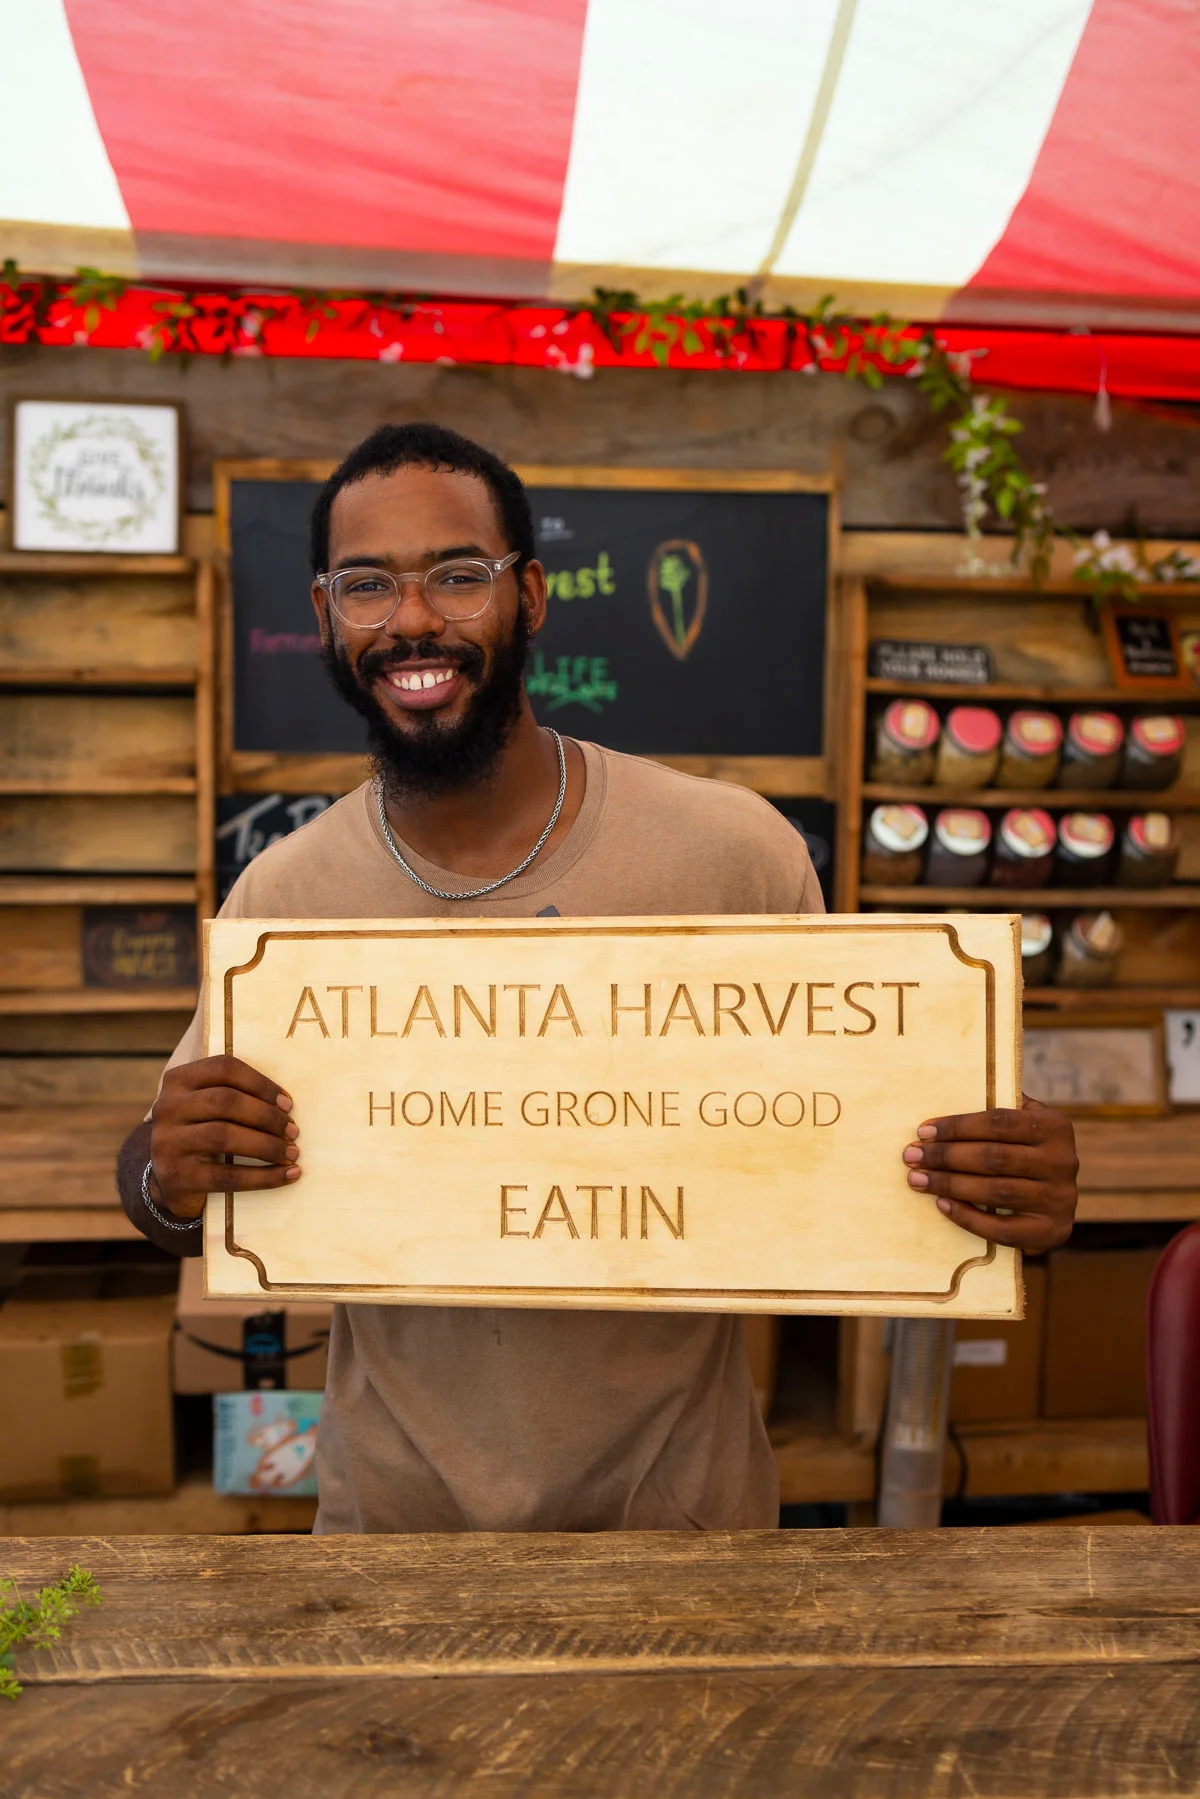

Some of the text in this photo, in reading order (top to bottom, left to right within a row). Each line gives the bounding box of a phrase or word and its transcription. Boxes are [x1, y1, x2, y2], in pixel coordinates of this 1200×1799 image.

[286, 981, 920, 1039] ATLANTA HARVEST
[368, 1091, 842, 1128] HOME GRONE GOOD
[500, 1184, 685, 1240] EATIN
